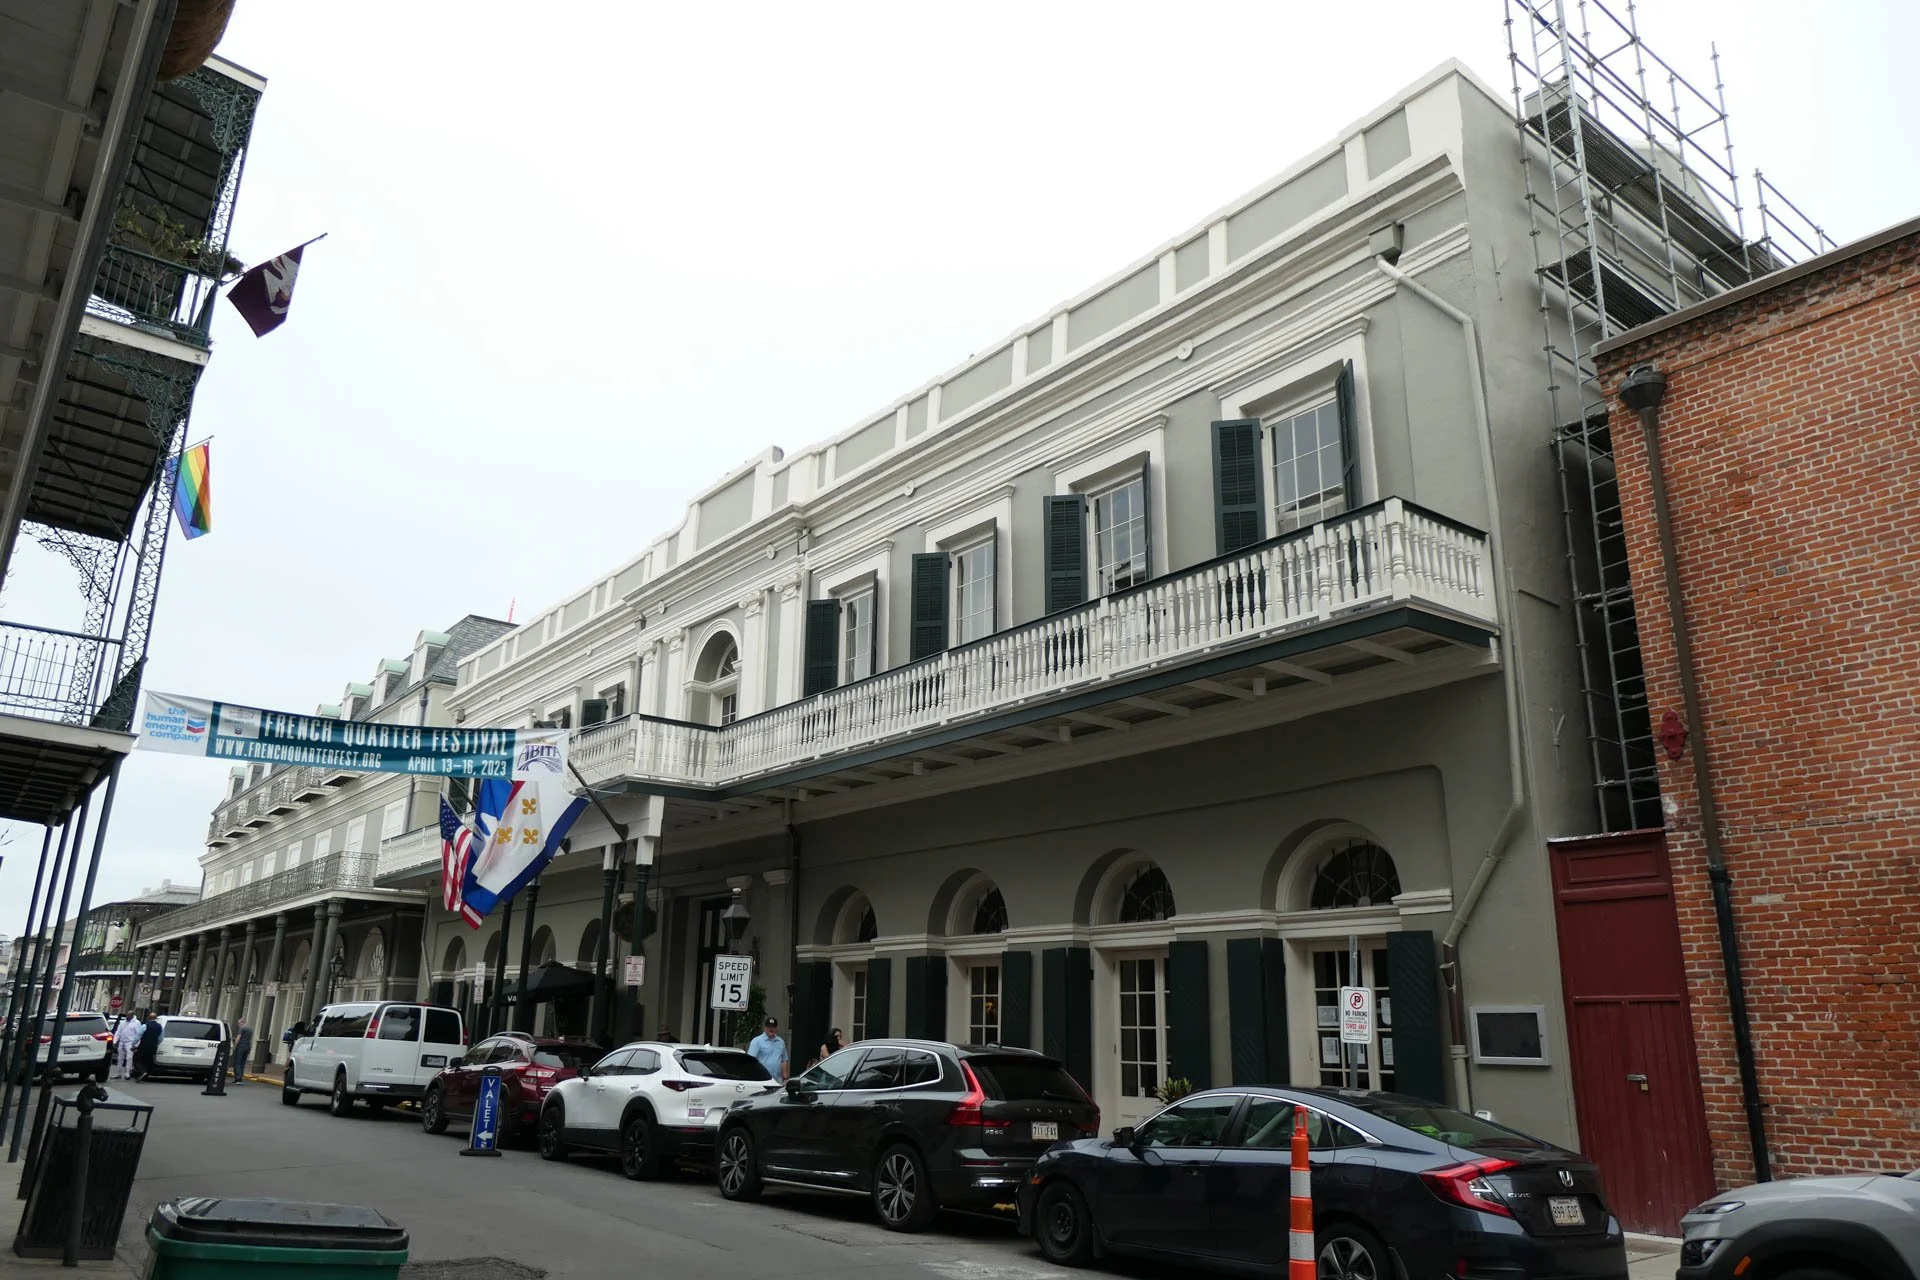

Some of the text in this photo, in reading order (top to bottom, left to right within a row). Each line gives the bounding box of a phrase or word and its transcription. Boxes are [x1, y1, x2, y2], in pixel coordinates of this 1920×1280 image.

[146, 712, 185, 724] human
[168, 706, 187, 715] the
[145, 721, 184, 733] energy
[149, 730, 201, 743] company
[265, 712, 508, 755] FRENCH QUARTER FESTIVAL
[215, 738, 382, 769] WWW.FRENCHQUARTERFEST.ORG
[518, 744, 562, 764] ABITA
[408, 756, 436, 772] APRIL
[481, 760, 507, 776] 2023
[718, 961, 749, 971] SPEED
[720, 972, 744, 982] LIMIT
[720, 983, 742, 1003] 15
[214, 1056, 224, 1083] VALET
[483, 1078, 496, 1129] VALET
